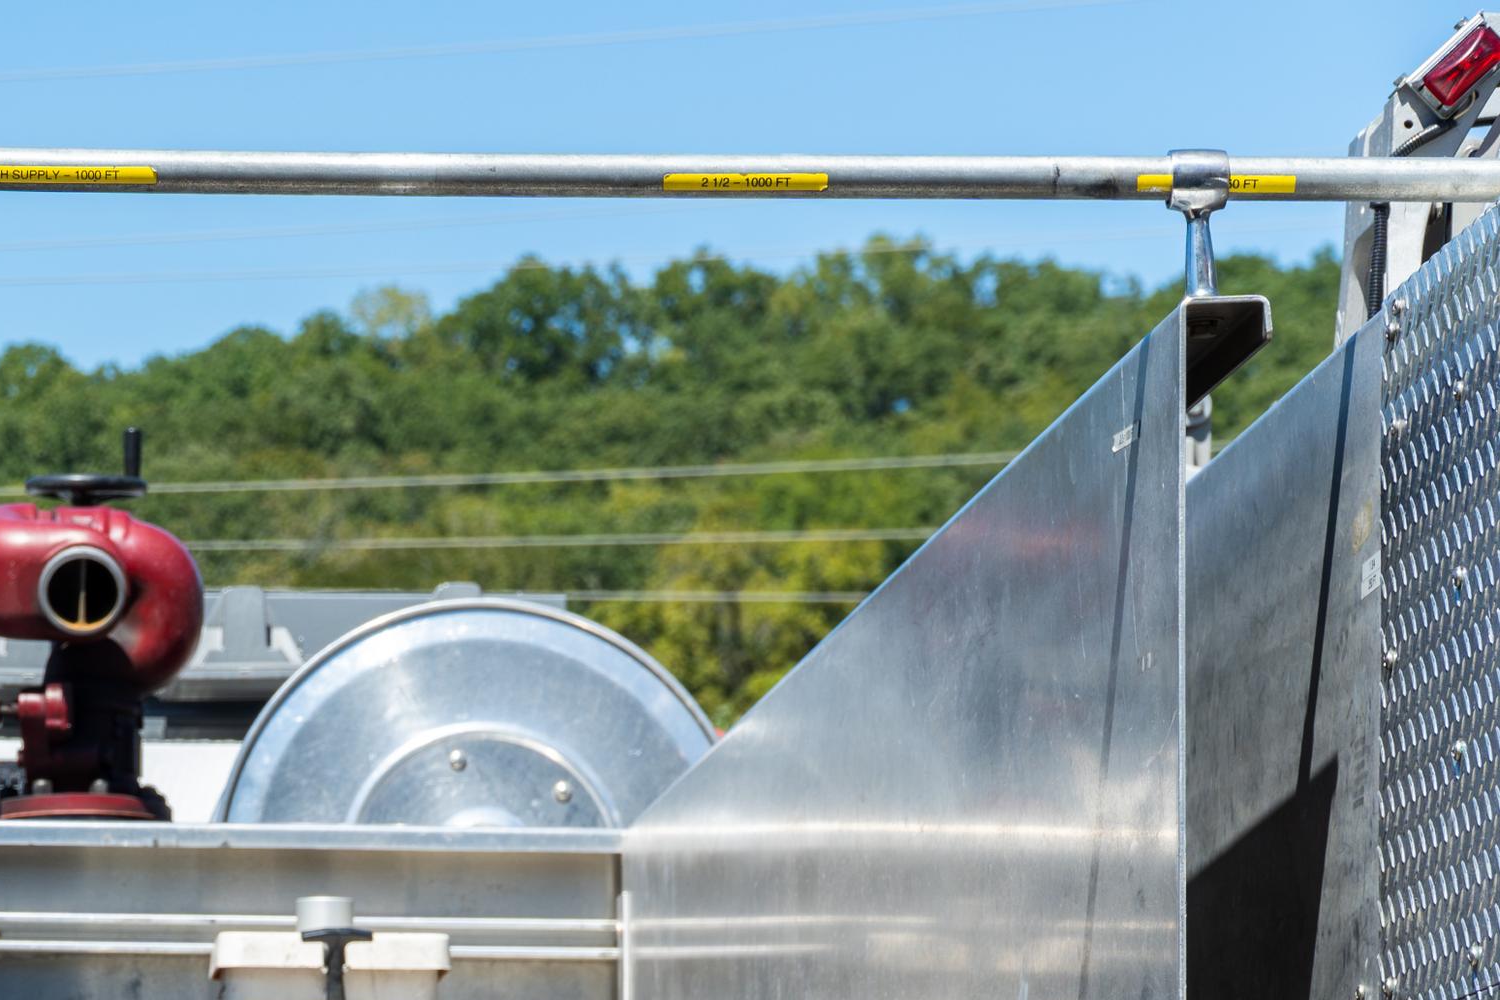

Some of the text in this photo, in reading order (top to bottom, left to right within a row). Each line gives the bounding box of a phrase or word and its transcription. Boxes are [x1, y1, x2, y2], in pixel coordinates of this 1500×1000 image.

[12, 170, 60, 180] SUPPLY
[75, 170, 102, 182] 1000
[105, 171, 120, 180] FT
[702, 178, 708, 187] 2
[713, 178, 730, 187] 1/2
[746, 178, 772, 187] 1000
[776, 178, 791, 187] FT
[1243, 179, 1259, 189] FT
